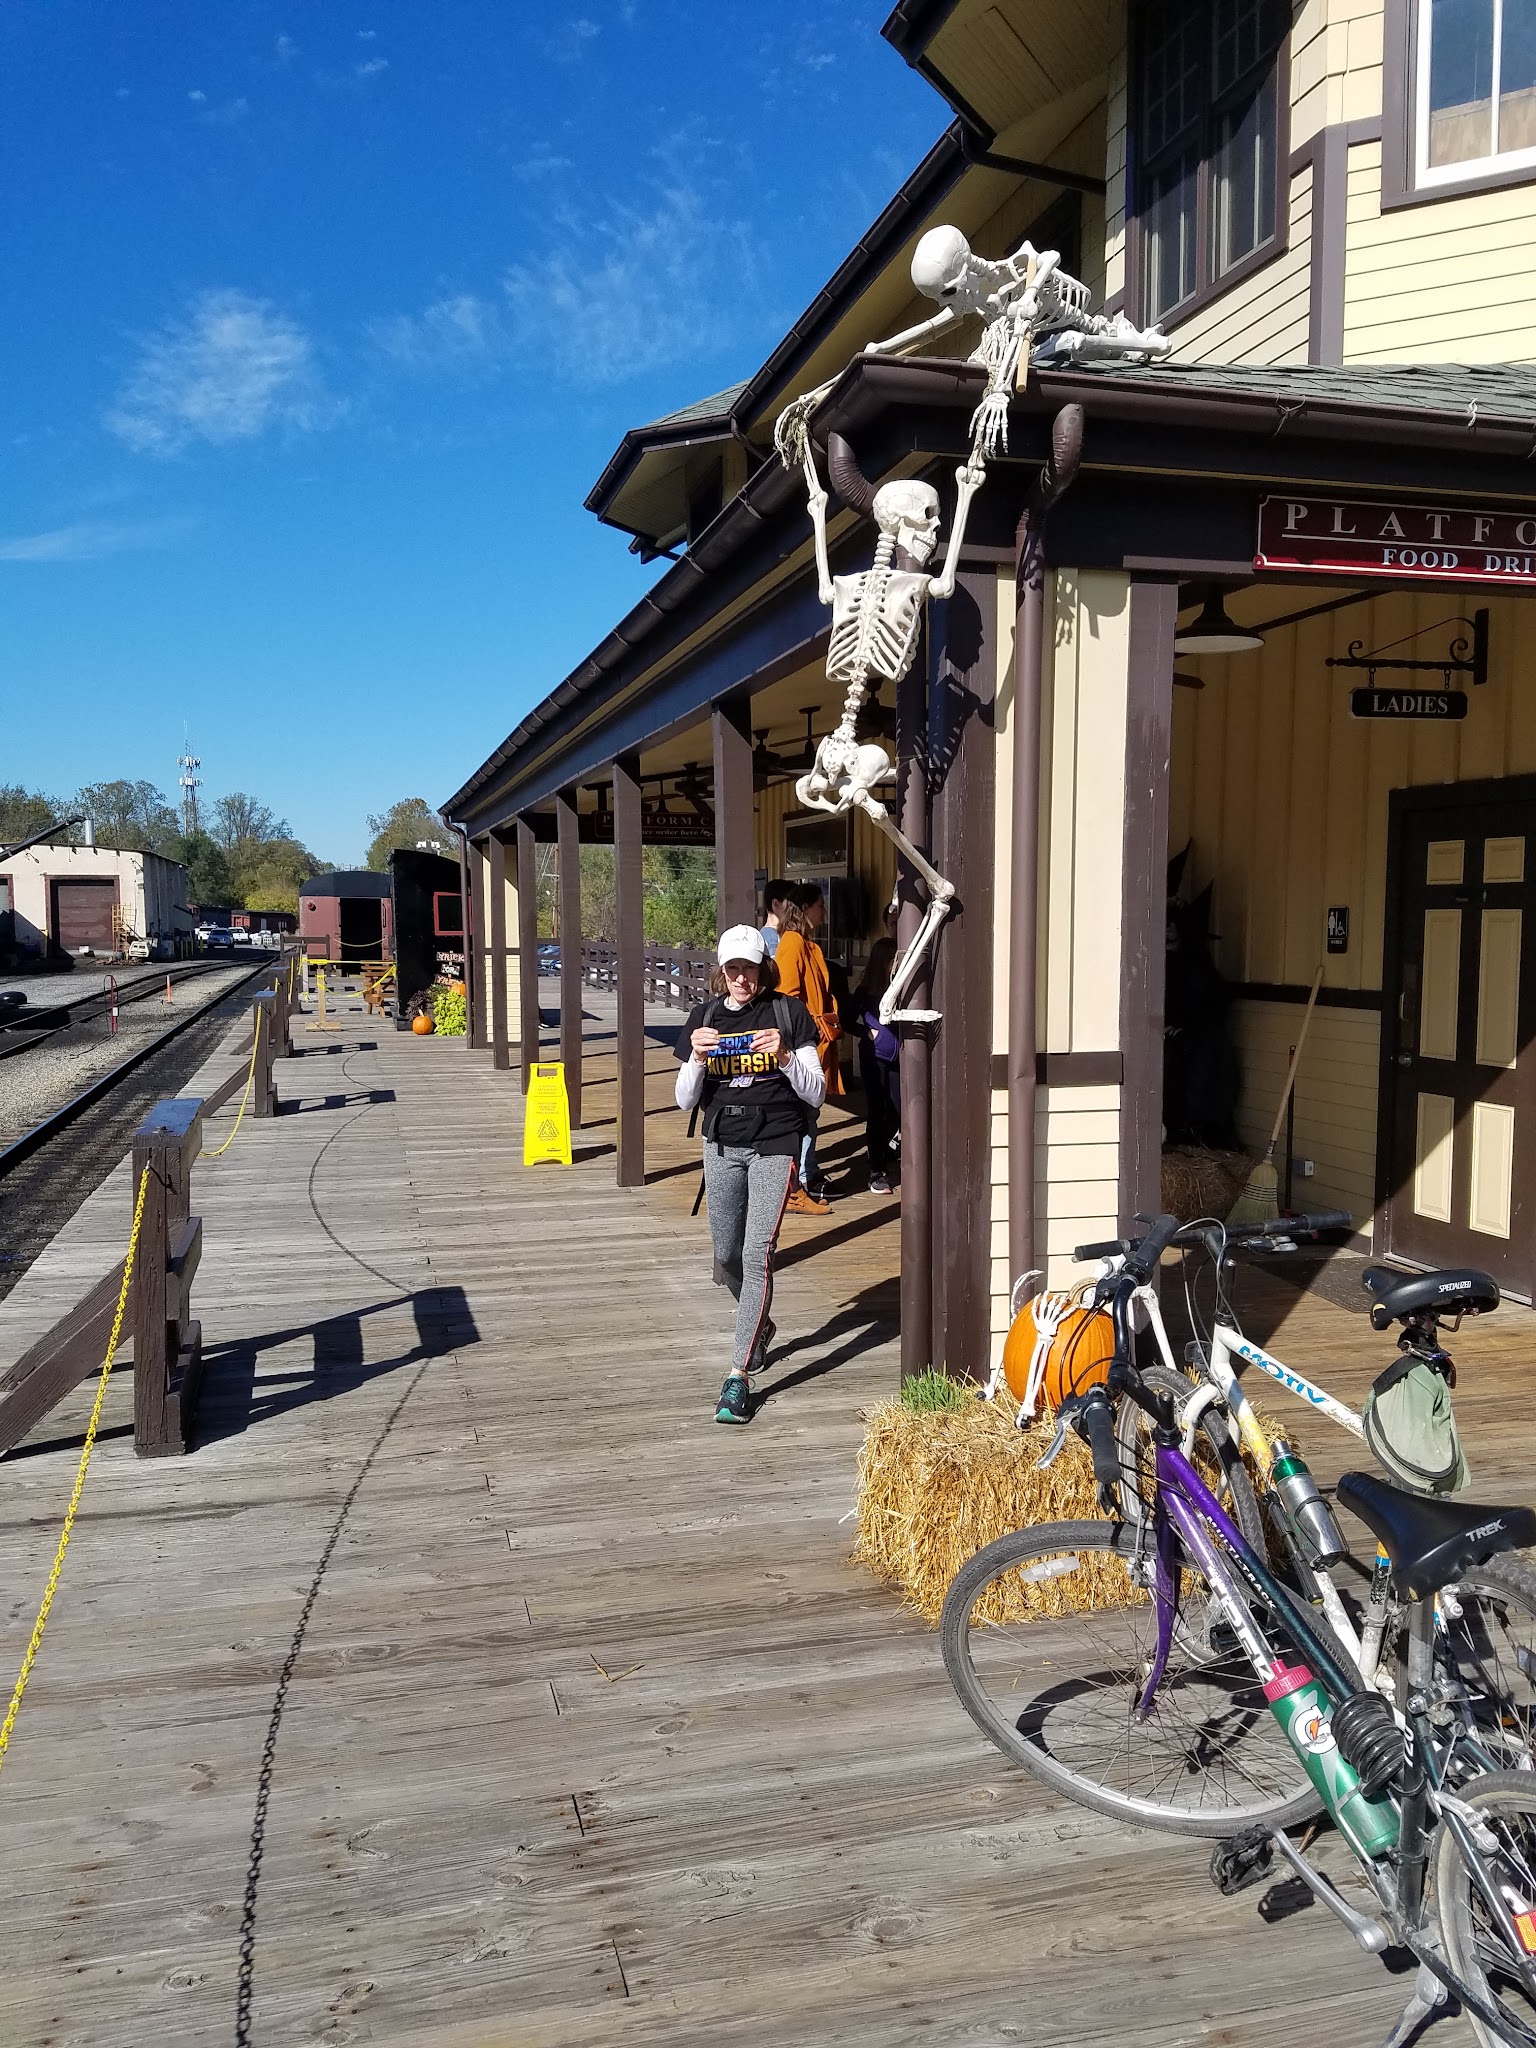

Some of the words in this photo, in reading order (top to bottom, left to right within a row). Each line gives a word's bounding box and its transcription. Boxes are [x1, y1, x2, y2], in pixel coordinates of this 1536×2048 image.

[1382, 548, 1459, 569] FOOD
[1484, 554, 1536, 574] DRI
[1373, 694, 1448, 714] LADIES
[680, 829, 699, 837] here
[707, 1052, 779, 1076] NIVERSIT
[1438, 1280, 1472, 1294] SPECIALIZED
[1465, 1518, 1504, 1542] TREK
[1206, 1516, 1277, 1609] MULTI-TRACK
